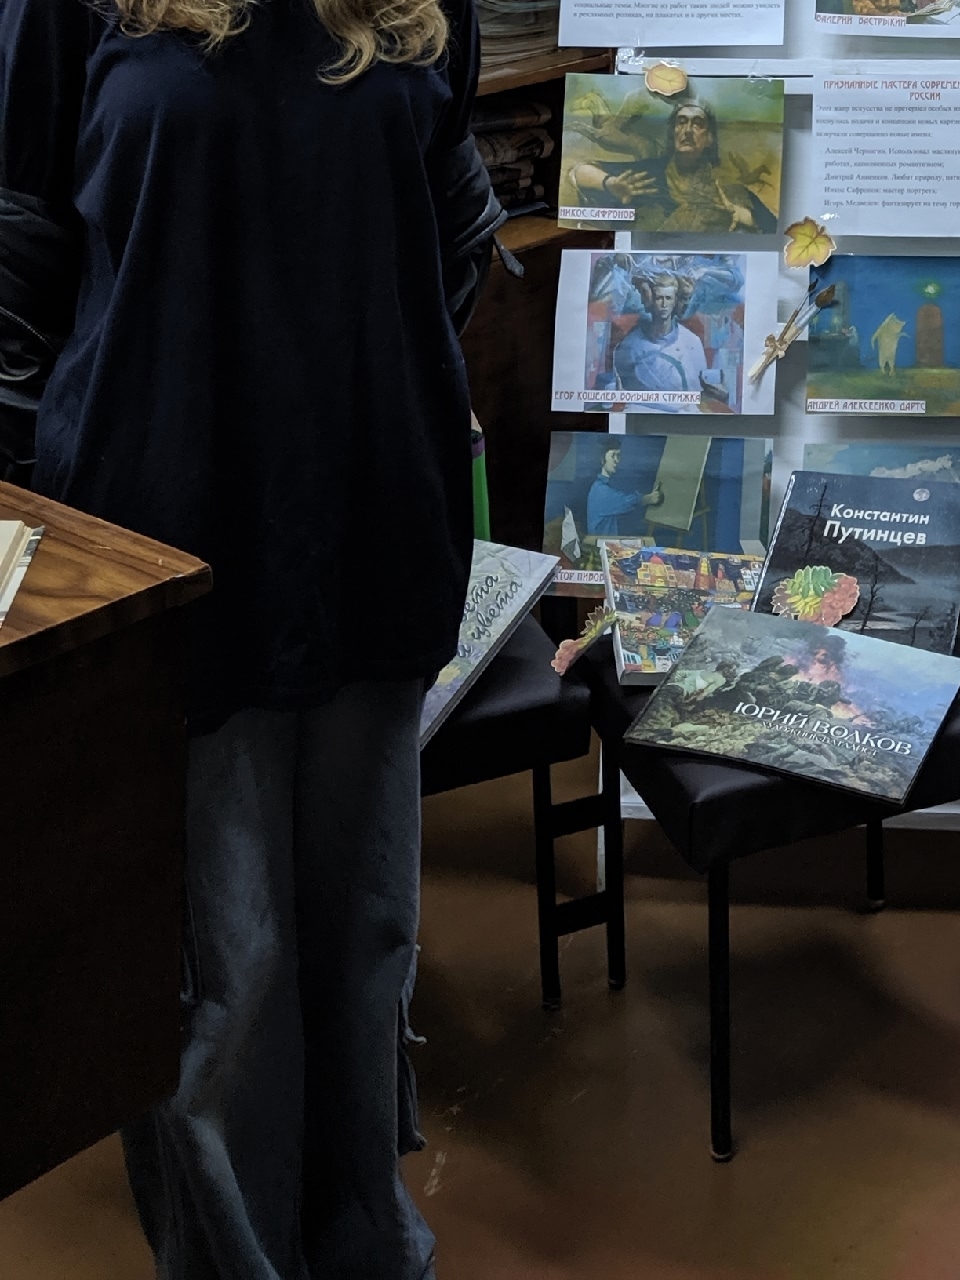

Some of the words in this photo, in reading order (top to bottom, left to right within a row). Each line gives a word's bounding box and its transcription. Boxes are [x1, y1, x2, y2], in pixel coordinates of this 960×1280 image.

[859, 16, 907, 27] БАСТРЫКИН
[823, 81, 878, 89] ПРИЗНАННЫЕ
[882, 81, 918, 89] МАСТЕРА
[909, 92, 941, 100] РОССИИ
[560, 208, 587, 218] НИКОС
[590, 209, 635, 219] САФРОНОВ
[554, 392, 574, 400] ЕГОР
[620, 393, 659, 401] БОЛЬШАЯ
[663, 394, 700, 402] СТРИЖКА
[807, 401, 840, 410] АНДРЕЙ
[900, 402, 925, 411] ДАРТС
[830, 503, 930, 525] Константин
[823, 520, 927, 546] Путинцев
[733, 702, 808, 728] ЮРИЙ
[812, 720, 912, 756] ВОЛКОВ
